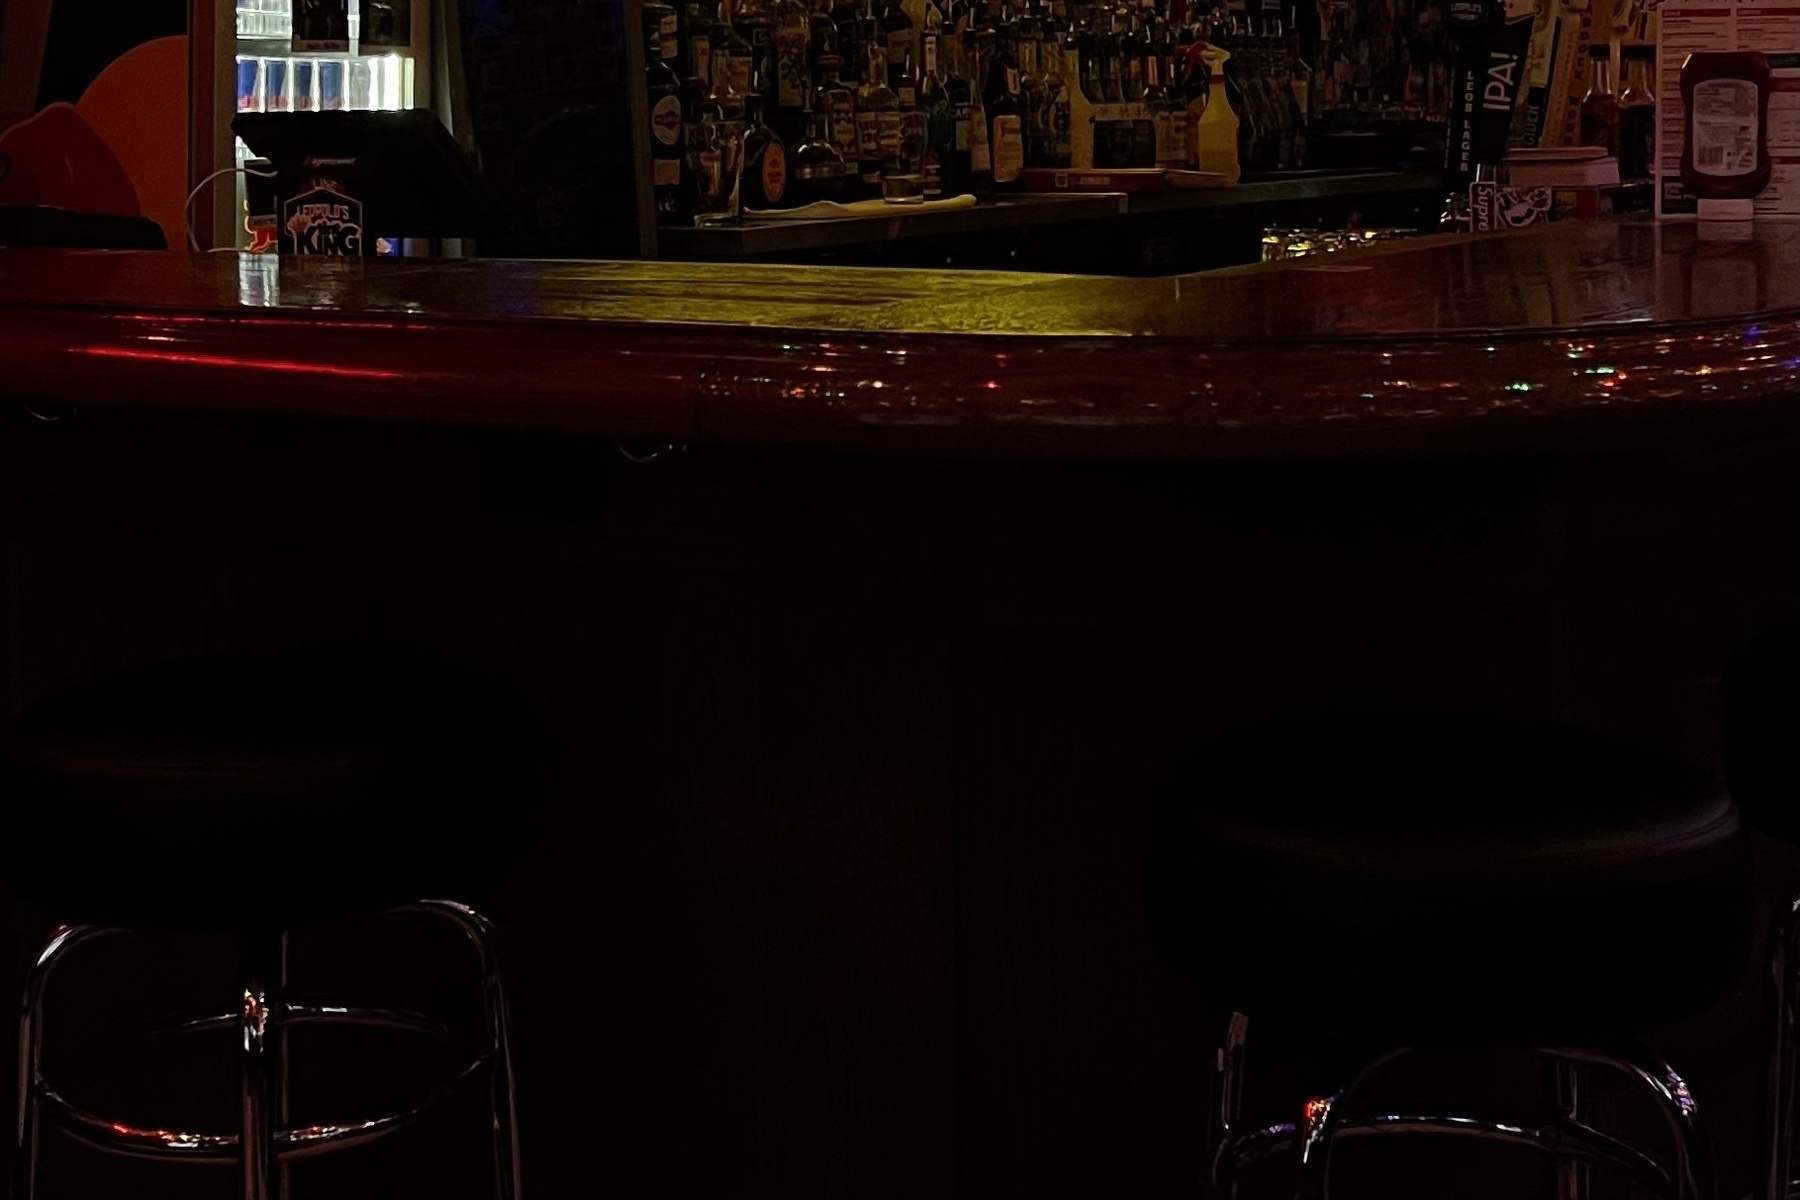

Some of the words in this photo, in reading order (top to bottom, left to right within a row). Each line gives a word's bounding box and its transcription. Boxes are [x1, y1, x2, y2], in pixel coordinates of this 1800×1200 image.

[1482, 51, 1519, 111] IPA!
[1459, 119, 1473, 173] LAGER
[298, 225, 361, 256] KING
